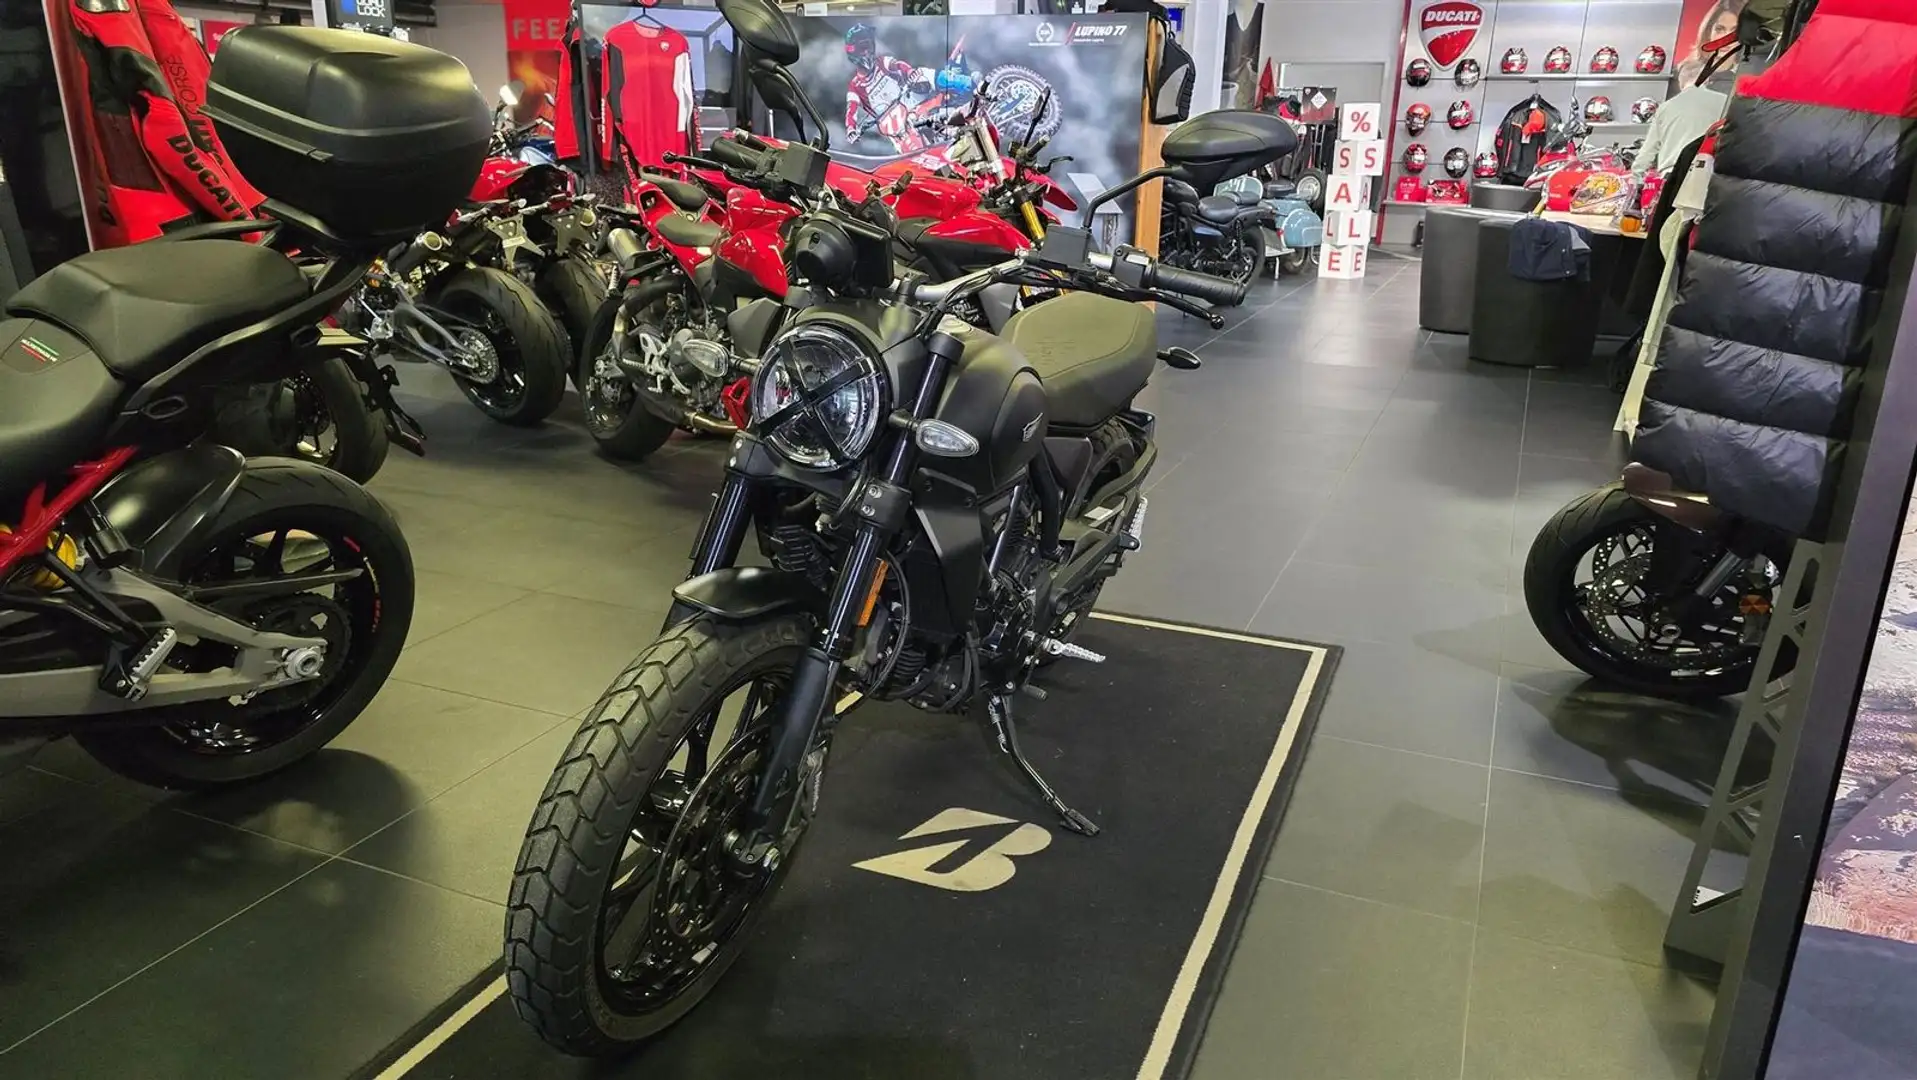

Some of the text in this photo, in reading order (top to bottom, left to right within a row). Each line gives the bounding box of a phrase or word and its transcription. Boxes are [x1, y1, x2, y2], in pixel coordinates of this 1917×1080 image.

[357, 5, 386, 17] LOCK
[1425, 11, 1478, 22] DUCATI
[1074, 25, 1127, 37] LUPINO 77
[1350, 111, 1371, 133] %
